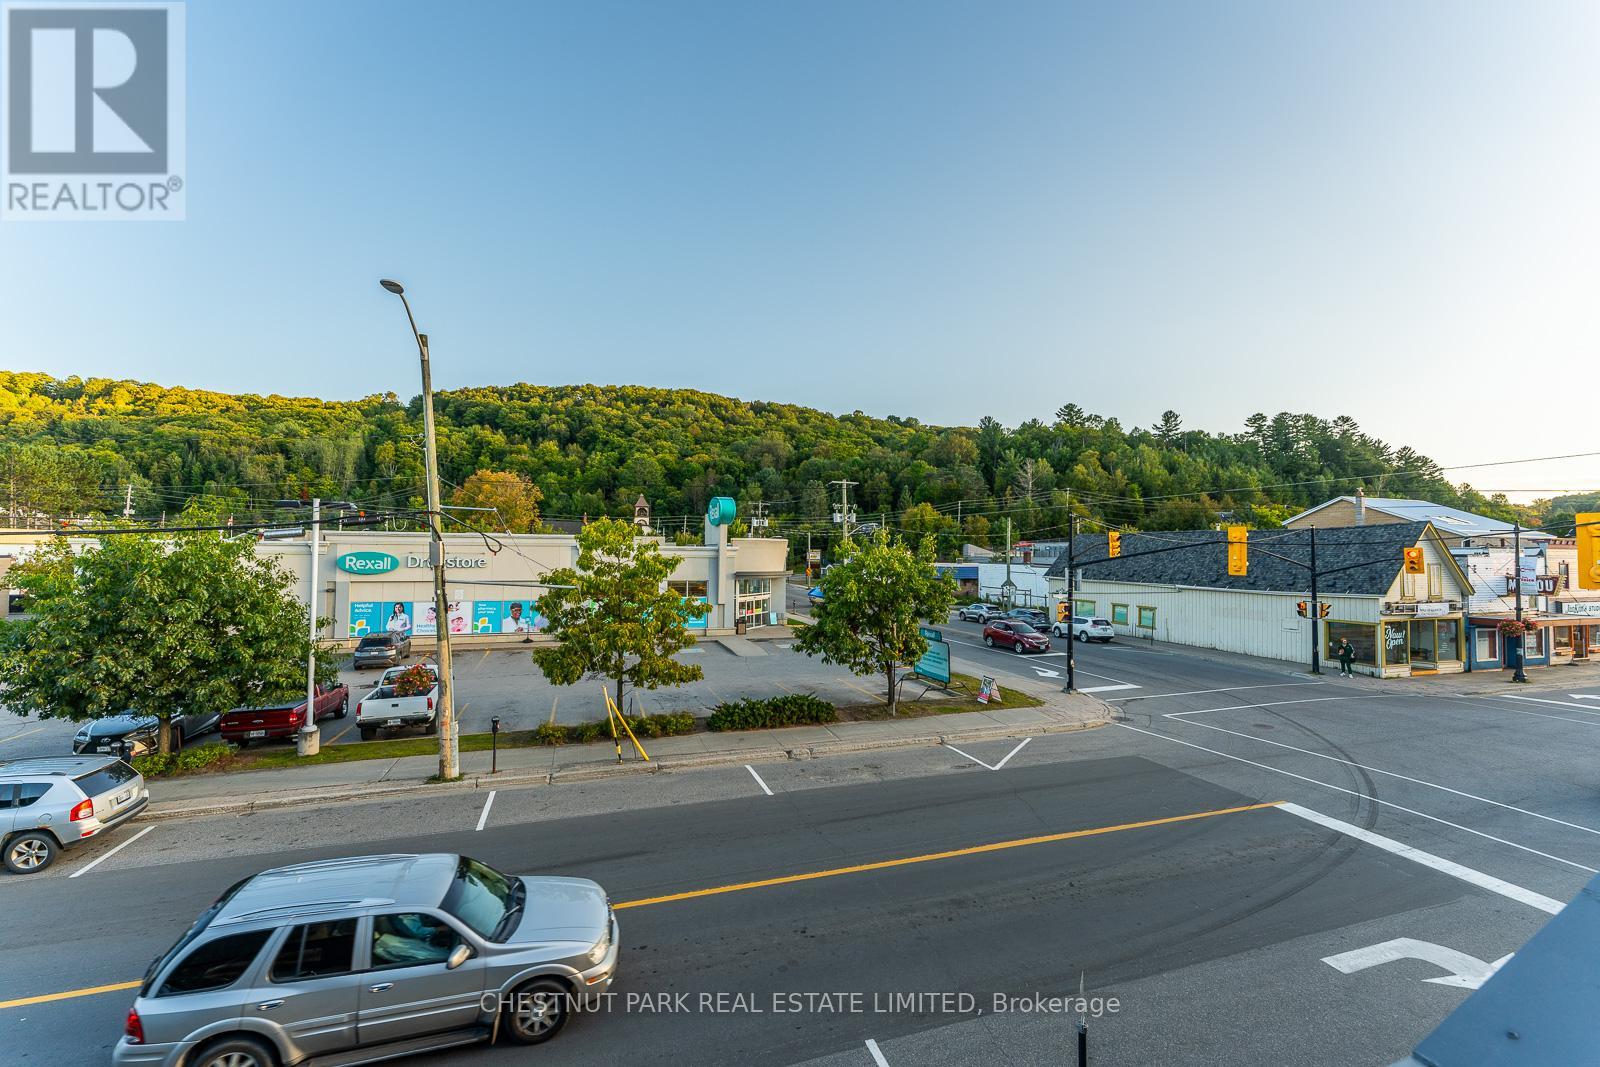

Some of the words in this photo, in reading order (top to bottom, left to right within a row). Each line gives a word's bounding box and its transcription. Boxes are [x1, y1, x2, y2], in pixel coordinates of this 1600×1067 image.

[345, 556, 391, 571] Rexall
[407, 555, 487, 569] Drstore
[1386, 638, 1404, 650] Open
